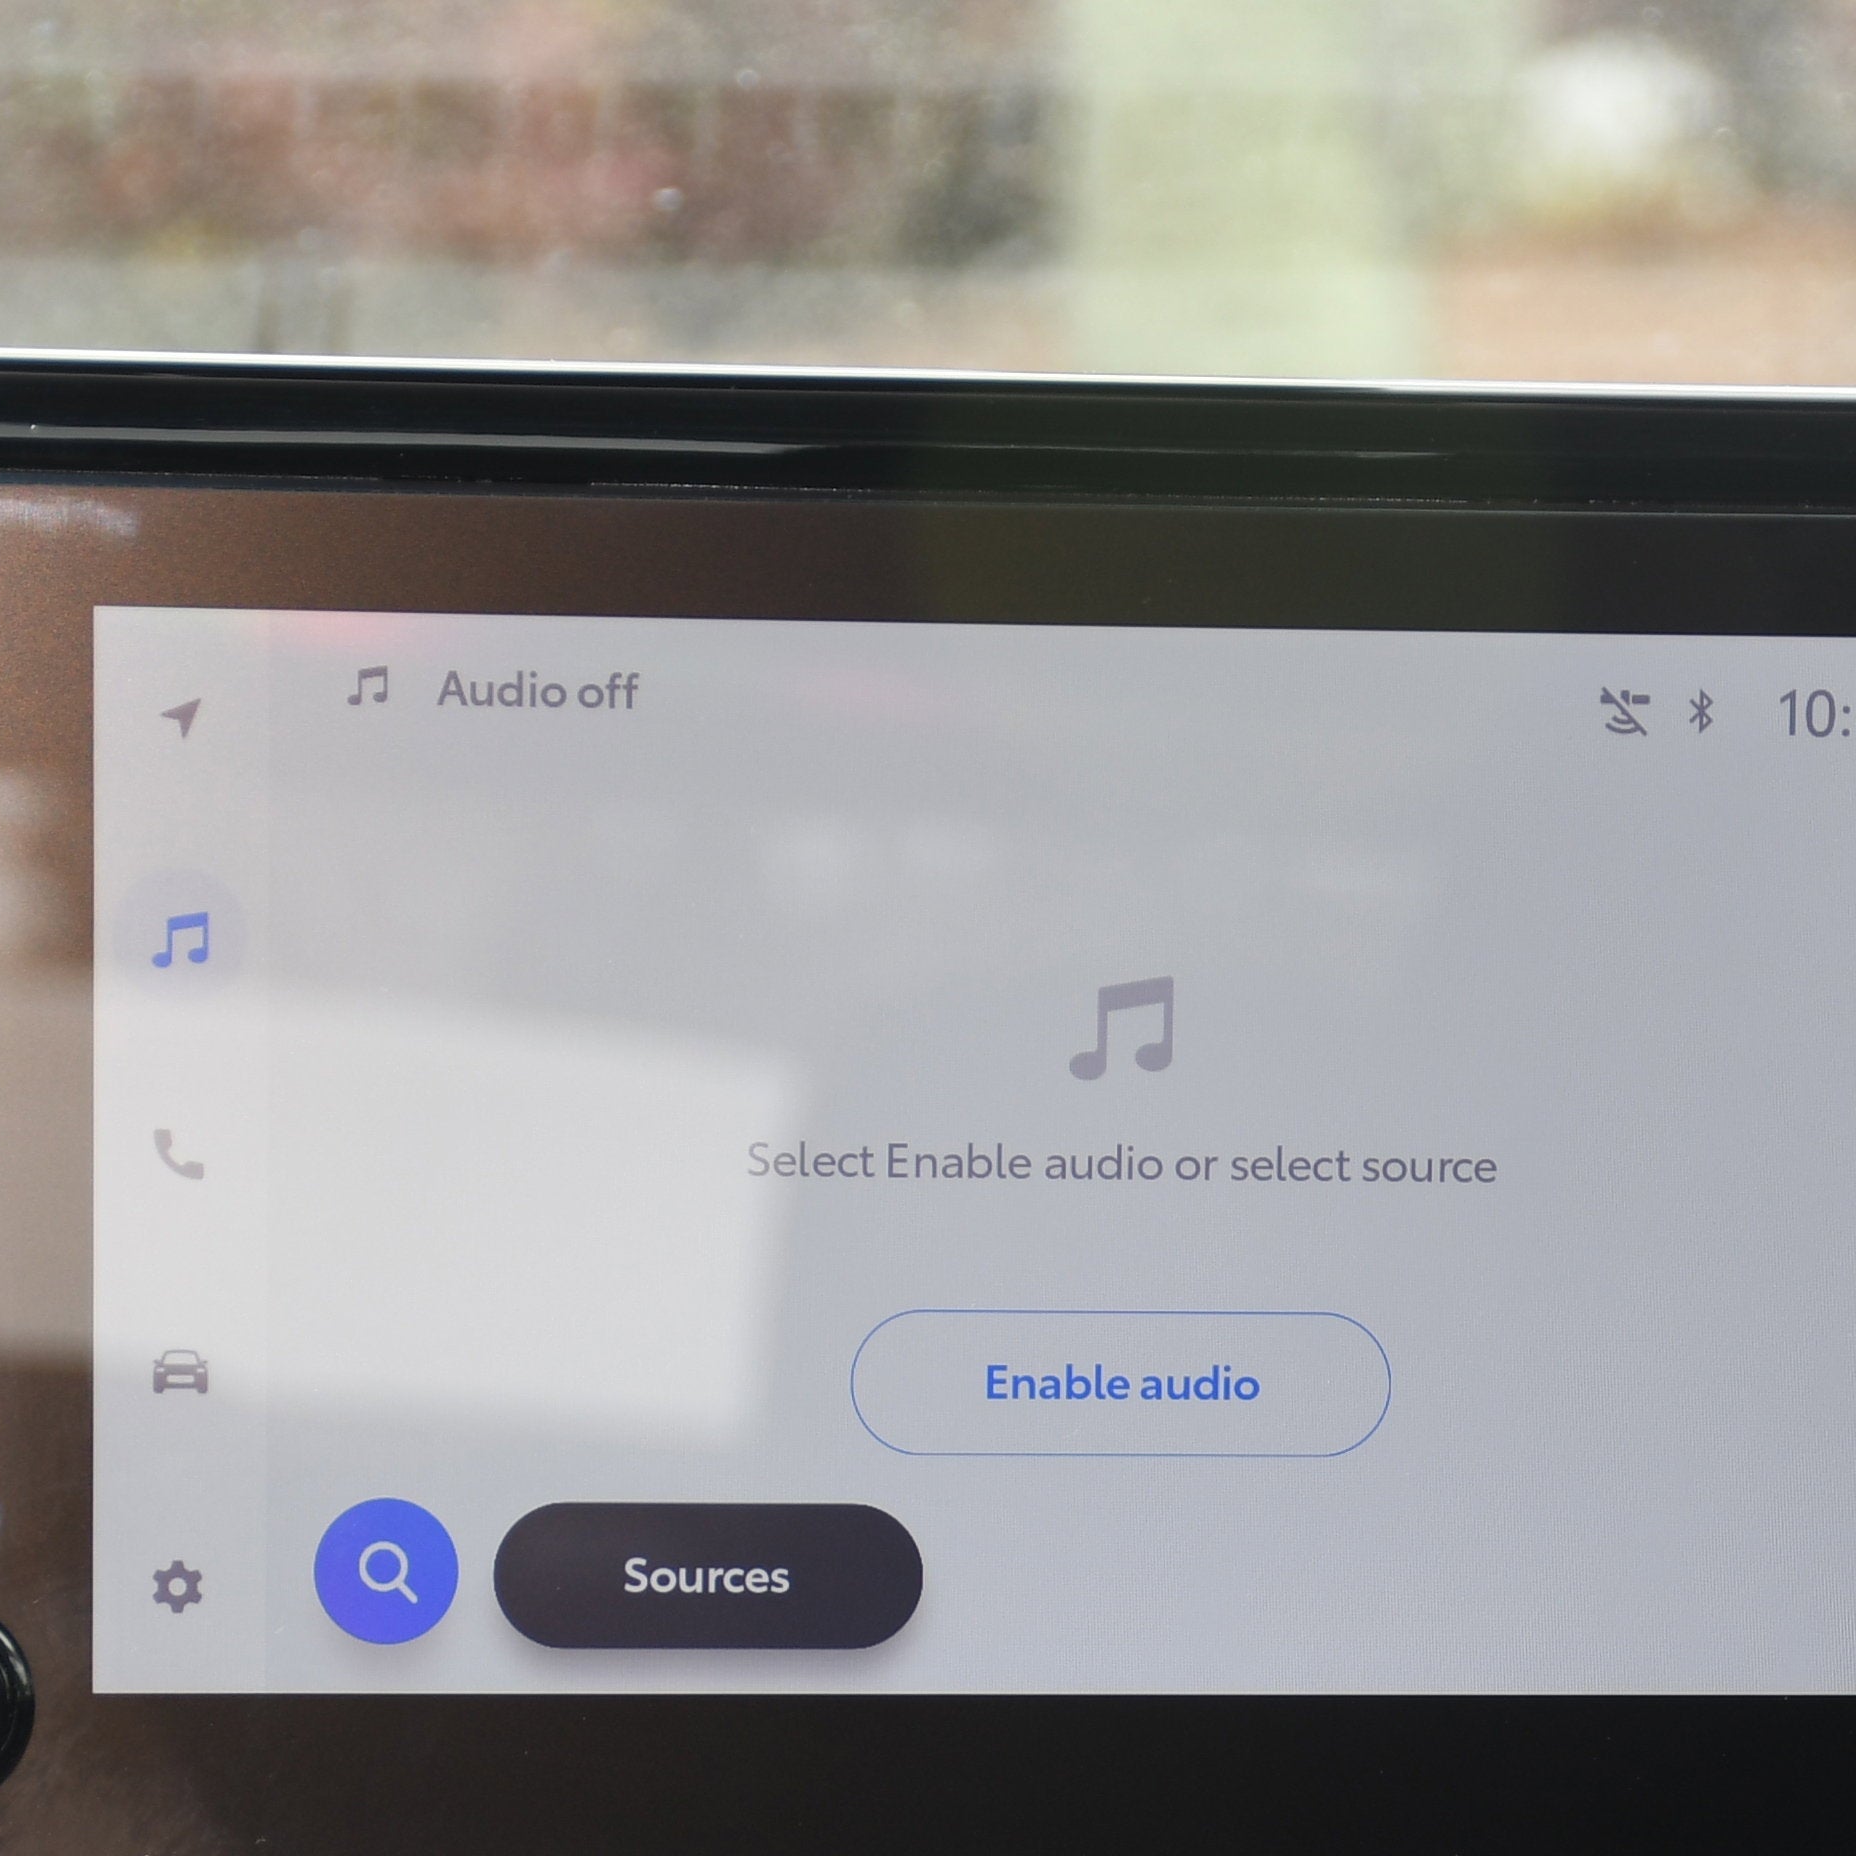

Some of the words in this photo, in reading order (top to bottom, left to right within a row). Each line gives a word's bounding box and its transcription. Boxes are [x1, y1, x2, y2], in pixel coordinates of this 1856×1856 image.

[435, 669, 568, 710] Audio
[576, 670, 642, 711] off
[746, 1140, 877, 1179] Select
[886, 1142, 1033, 1181] Enable
[1044, 1143, 1165, 1182] audio
[1174, 1156, 1220, 1183] or
[1229, 1145, 1353, 1184] select
[1360, 1154, 1500, 1185] source
[984, 1363, 1131, 1401] Enable
[1139, 1364, 1261, 1402] audio
[623, 1556, 791, 1595] Sources
